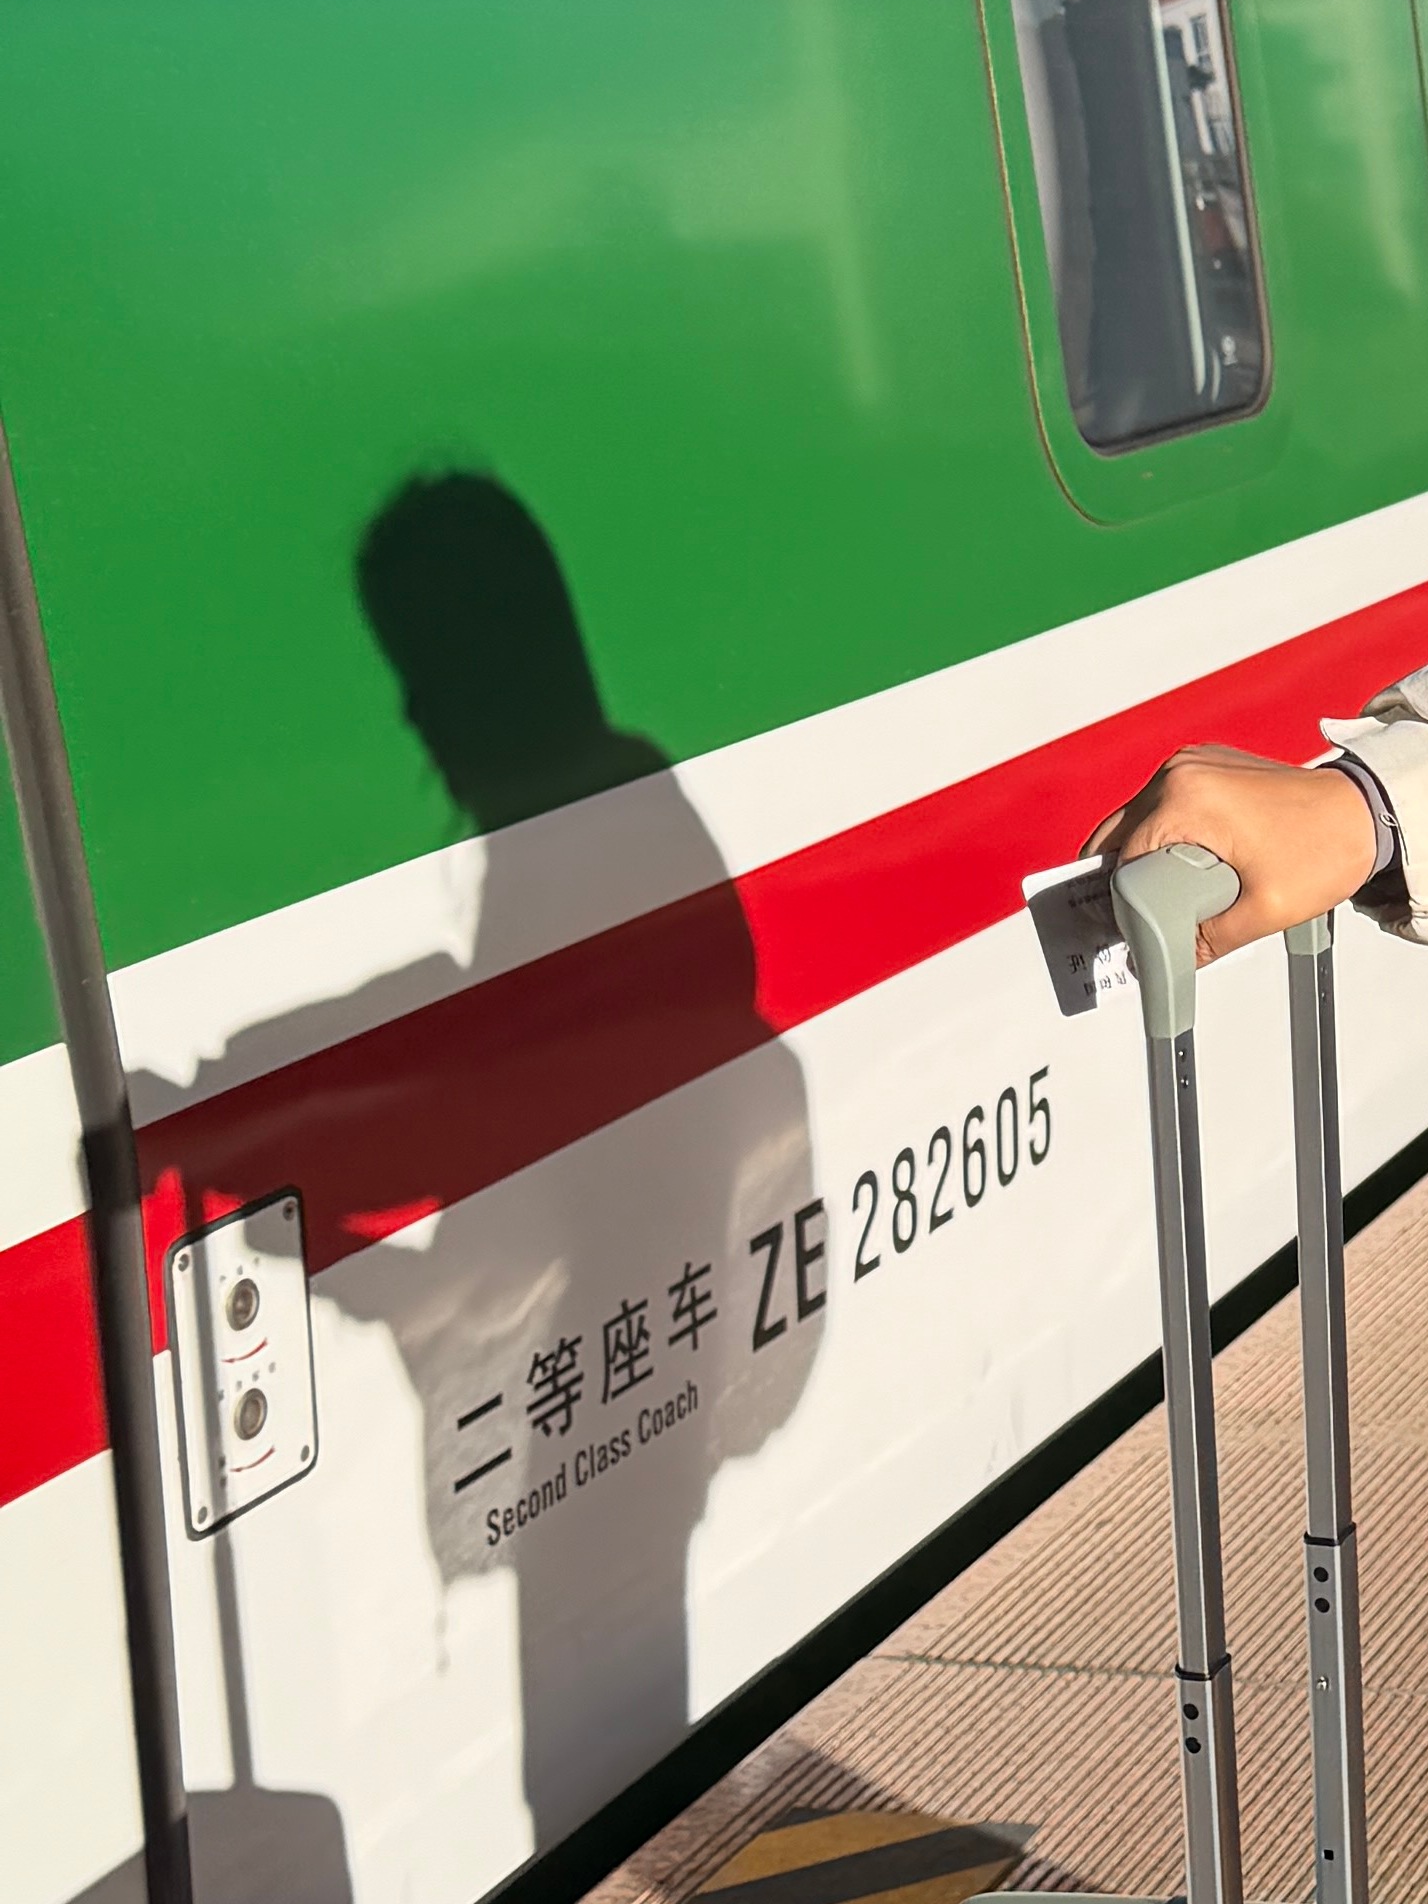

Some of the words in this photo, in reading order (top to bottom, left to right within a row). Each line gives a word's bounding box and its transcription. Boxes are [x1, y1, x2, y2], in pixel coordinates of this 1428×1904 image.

[452, 1260, 718, 1494] 二等座车
[748, 1197, 829, 1352] ZE
[852, 1065, 1053, 1284] 282605
[486, 1464, 568, 1547] Second
[574, 1430, 632, 1487] Class
[638, 1381, 699, 1446] Coach
